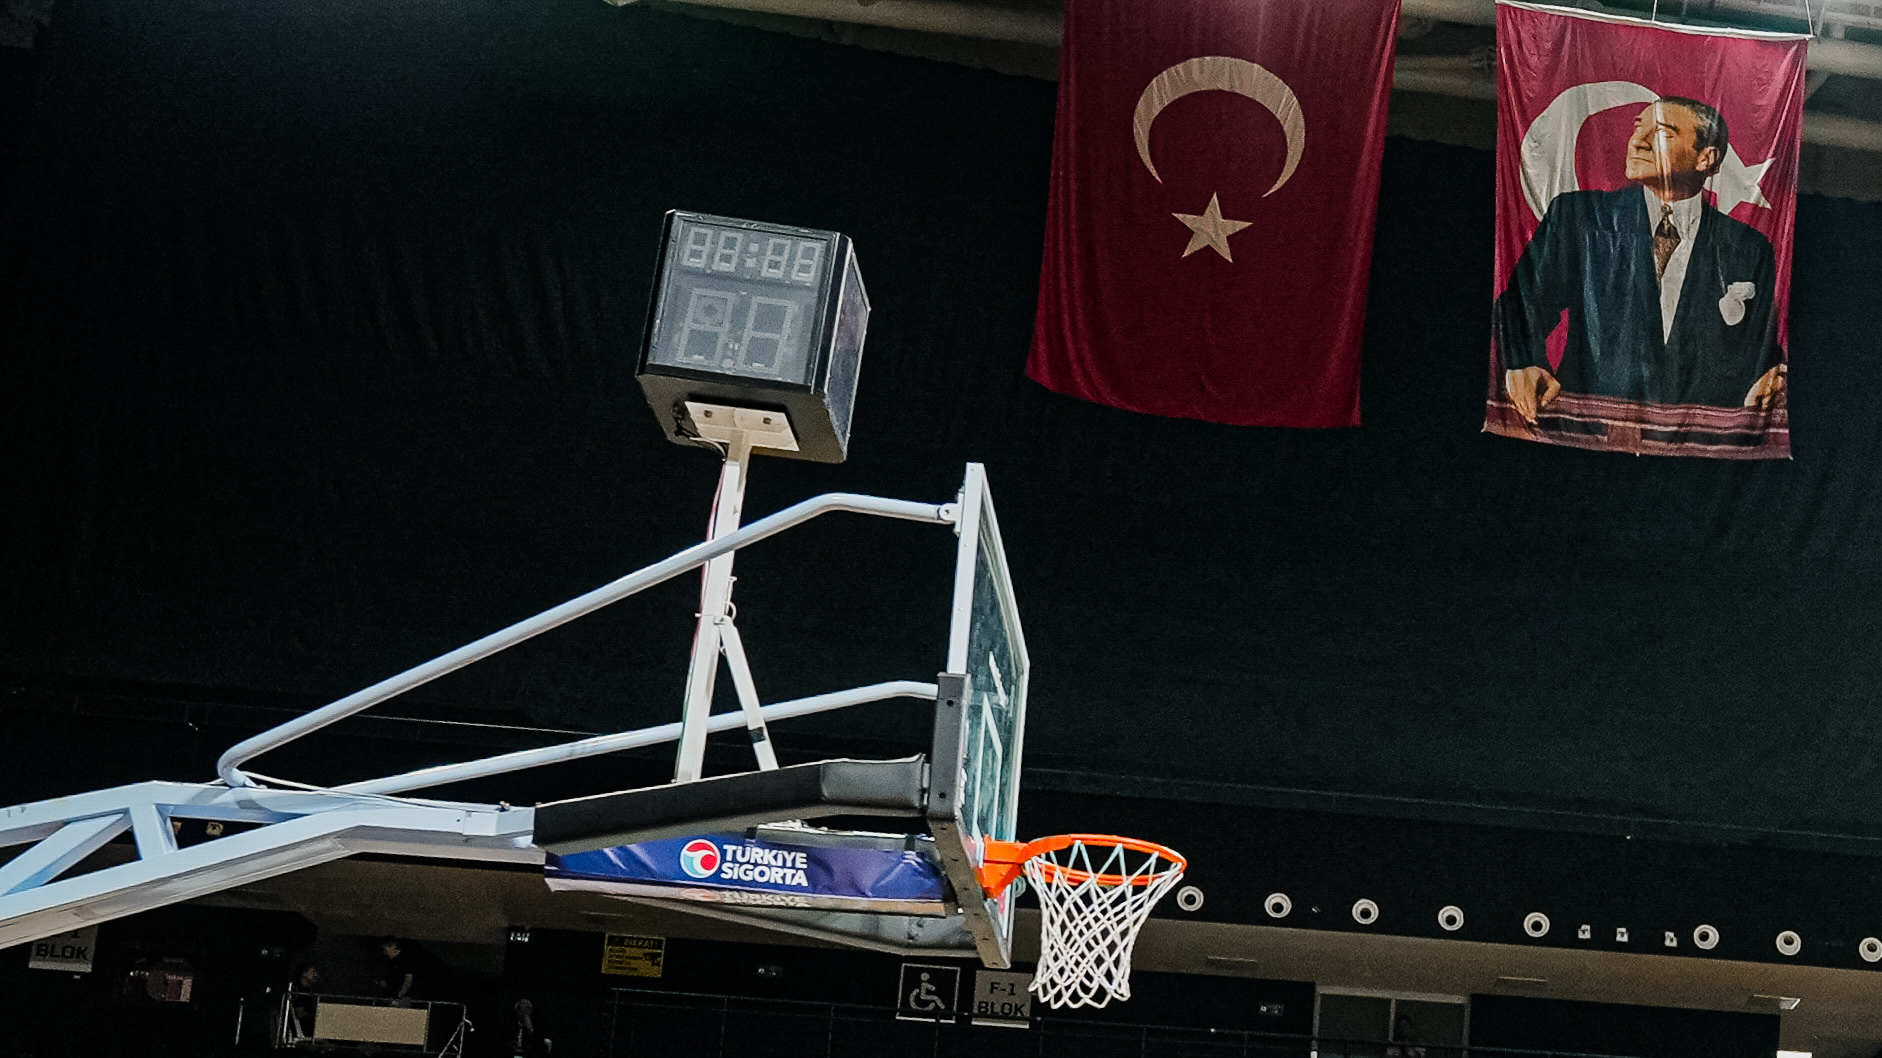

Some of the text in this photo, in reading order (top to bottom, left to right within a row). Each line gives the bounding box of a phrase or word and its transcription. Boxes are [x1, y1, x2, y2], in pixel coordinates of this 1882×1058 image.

[722, 844, 809, 869] TÜRKİYE
[36, 943, 88, 960] BLOK
[990, 982, 1016, 996] F-1
[978, 1001, 1025, 1016] BLOK
